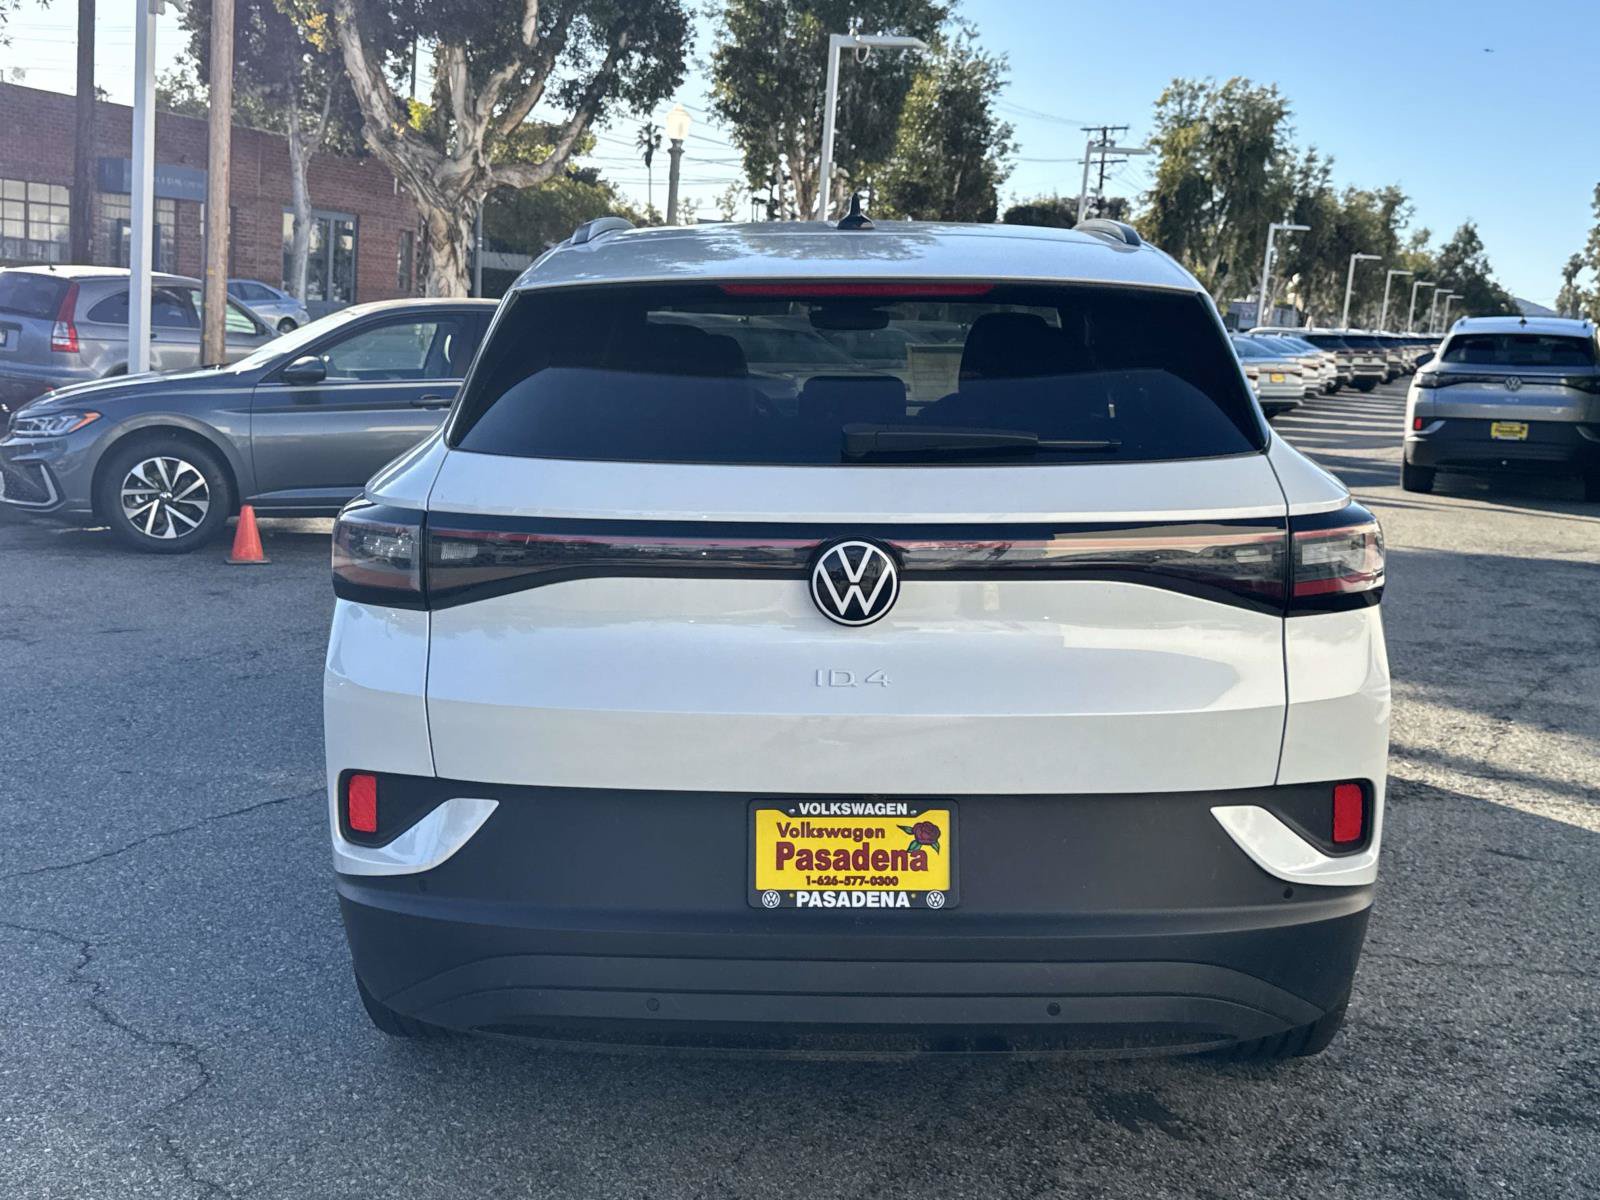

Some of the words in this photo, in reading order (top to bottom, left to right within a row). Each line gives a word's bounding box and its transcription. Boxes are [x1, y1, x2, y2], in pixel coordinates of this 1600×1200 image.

[814, 543, 896, 621] VW
[799, 803, 908, 815] VOLKSWAGEN
[776, 822, 885, 842] Volkswagen
[776, 841, 929, 872] Pasadena
[805, 875, 899, 886] 1-626-577-0300
[796, 891, 911, 908] PASADENA
